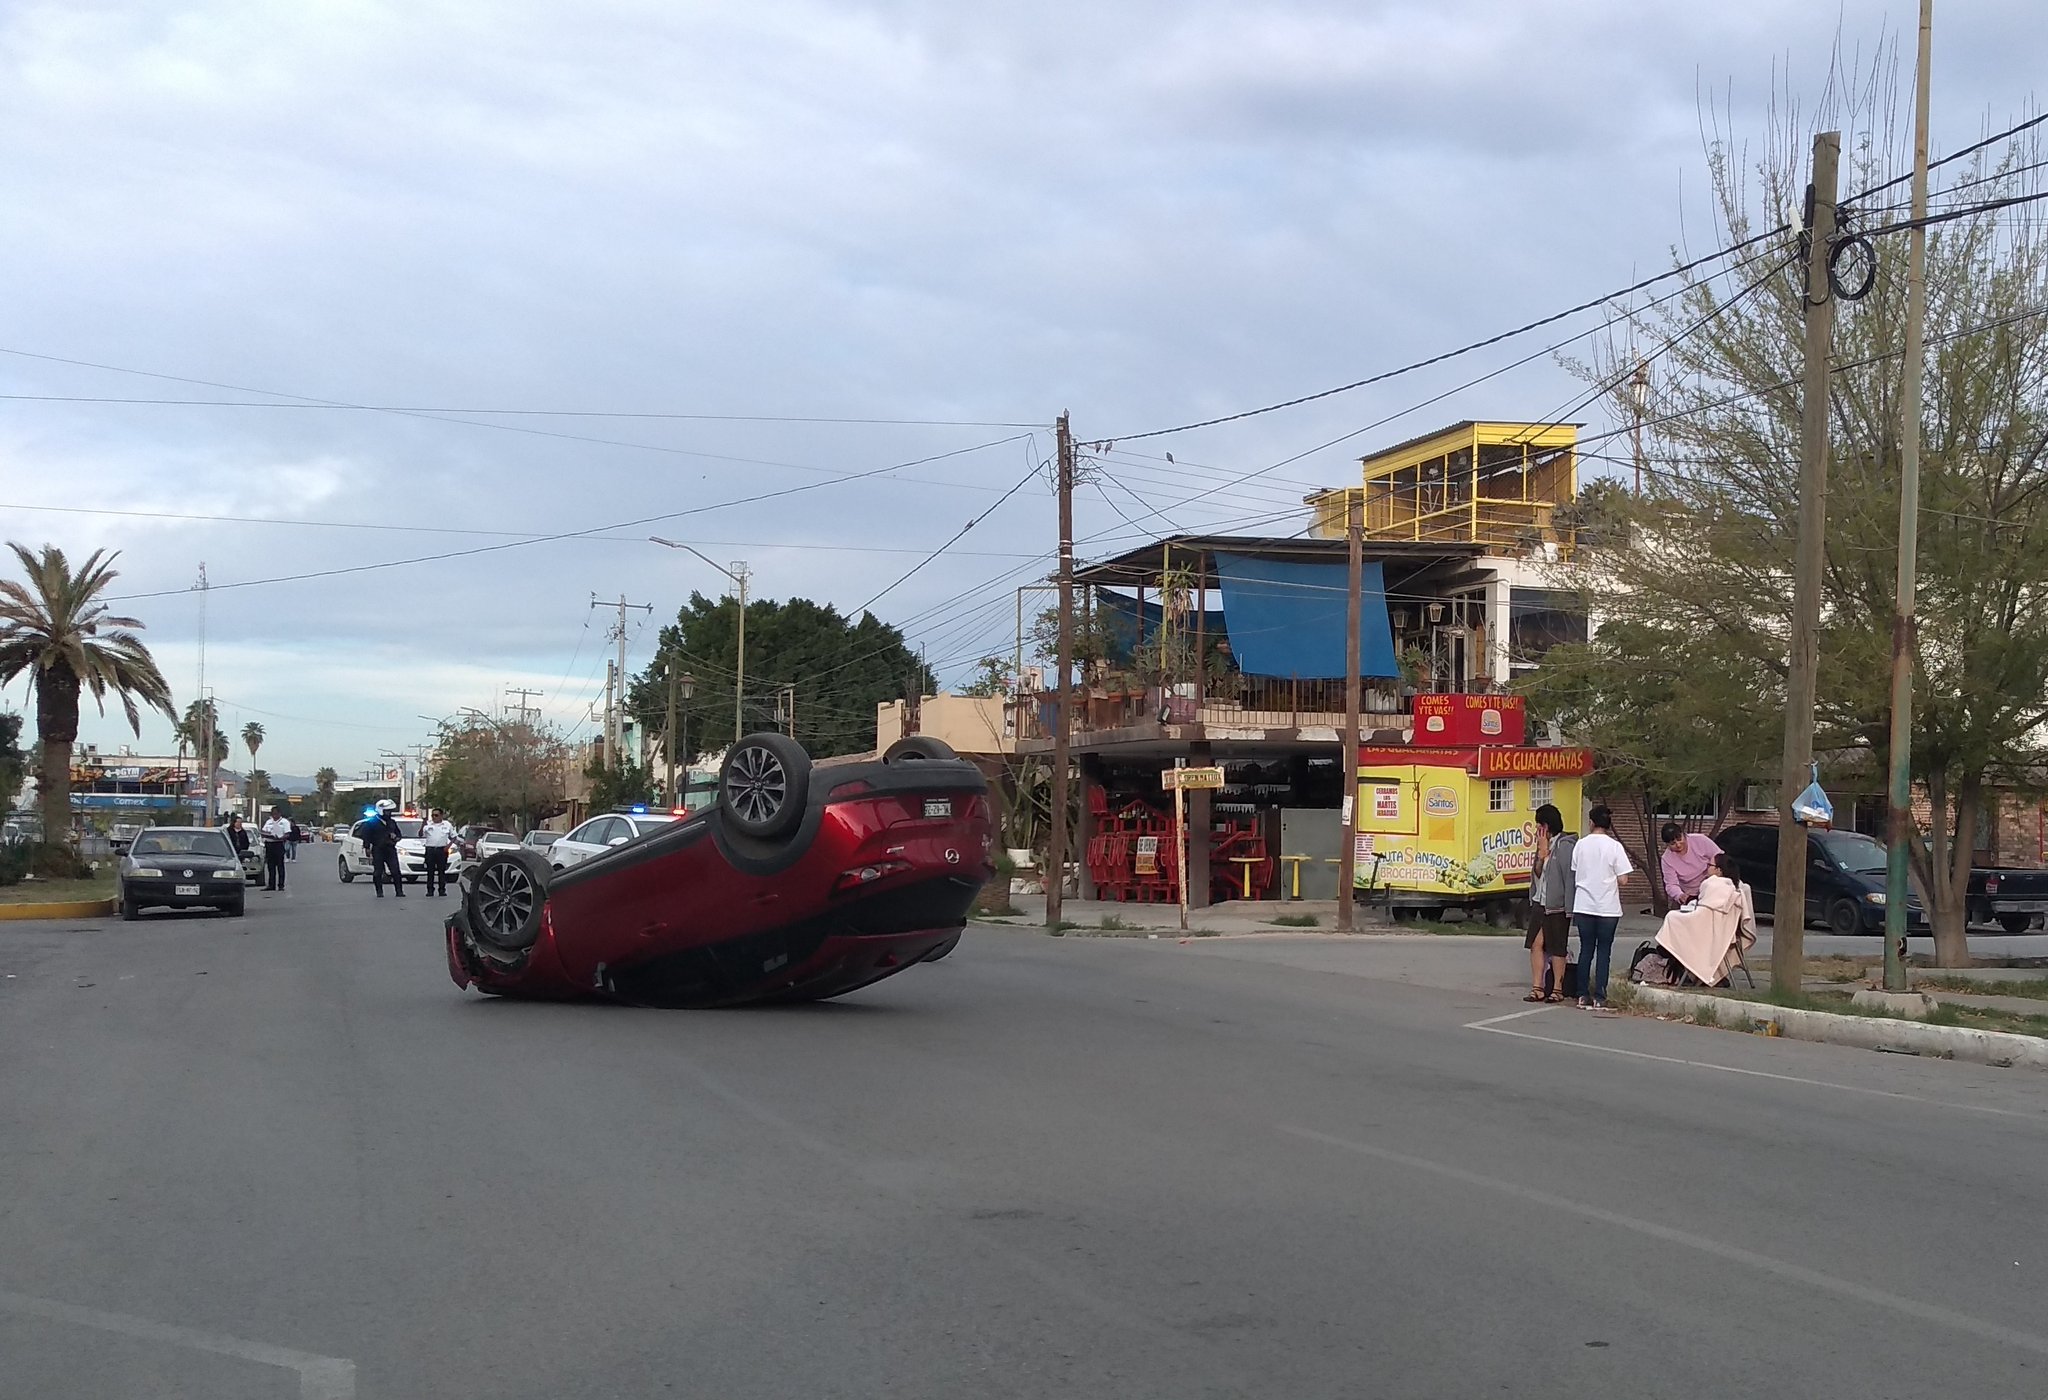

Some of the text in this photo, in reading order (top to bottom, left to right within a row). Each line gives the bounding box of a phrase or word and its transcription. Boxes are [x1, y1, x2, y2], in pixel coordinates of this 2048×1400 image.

[1421, 695, 1450, 705] COMES
[1465, 695, 1487, 709] COMES
[1490, 751, 1584, 771] LAS GUACAMAYAS
[121, 767, 140, 775] GYM
[1376, 787, 1398, 795] CERRAMOS
[1376, 801, 1397, 809] MARTES
[1428, 797, 1454, 809] Santos
[1380, 867, 1436, 880] BROCHETAS
